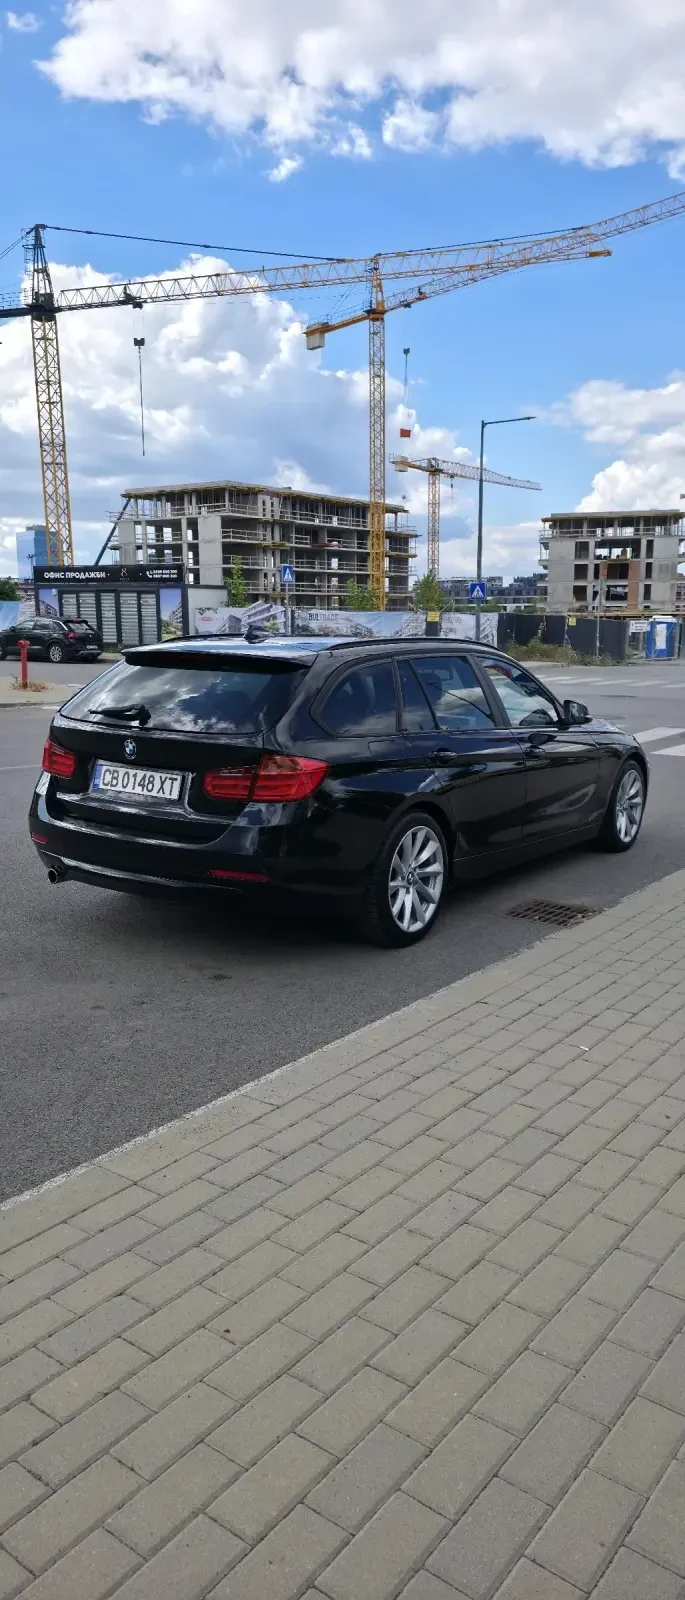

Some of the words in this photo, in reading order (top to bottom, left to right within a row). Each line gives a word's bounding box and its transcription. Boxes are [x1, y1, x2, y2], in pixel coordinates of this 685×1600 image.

[44, 571, 64, 579] ОФИС
[66, 571, 105, 579] ПРОДАЖБИ
[102, 768, 120, 788] CB
[121, 771, 155, 793] 0148
[157, 775, 178, 796] XT
